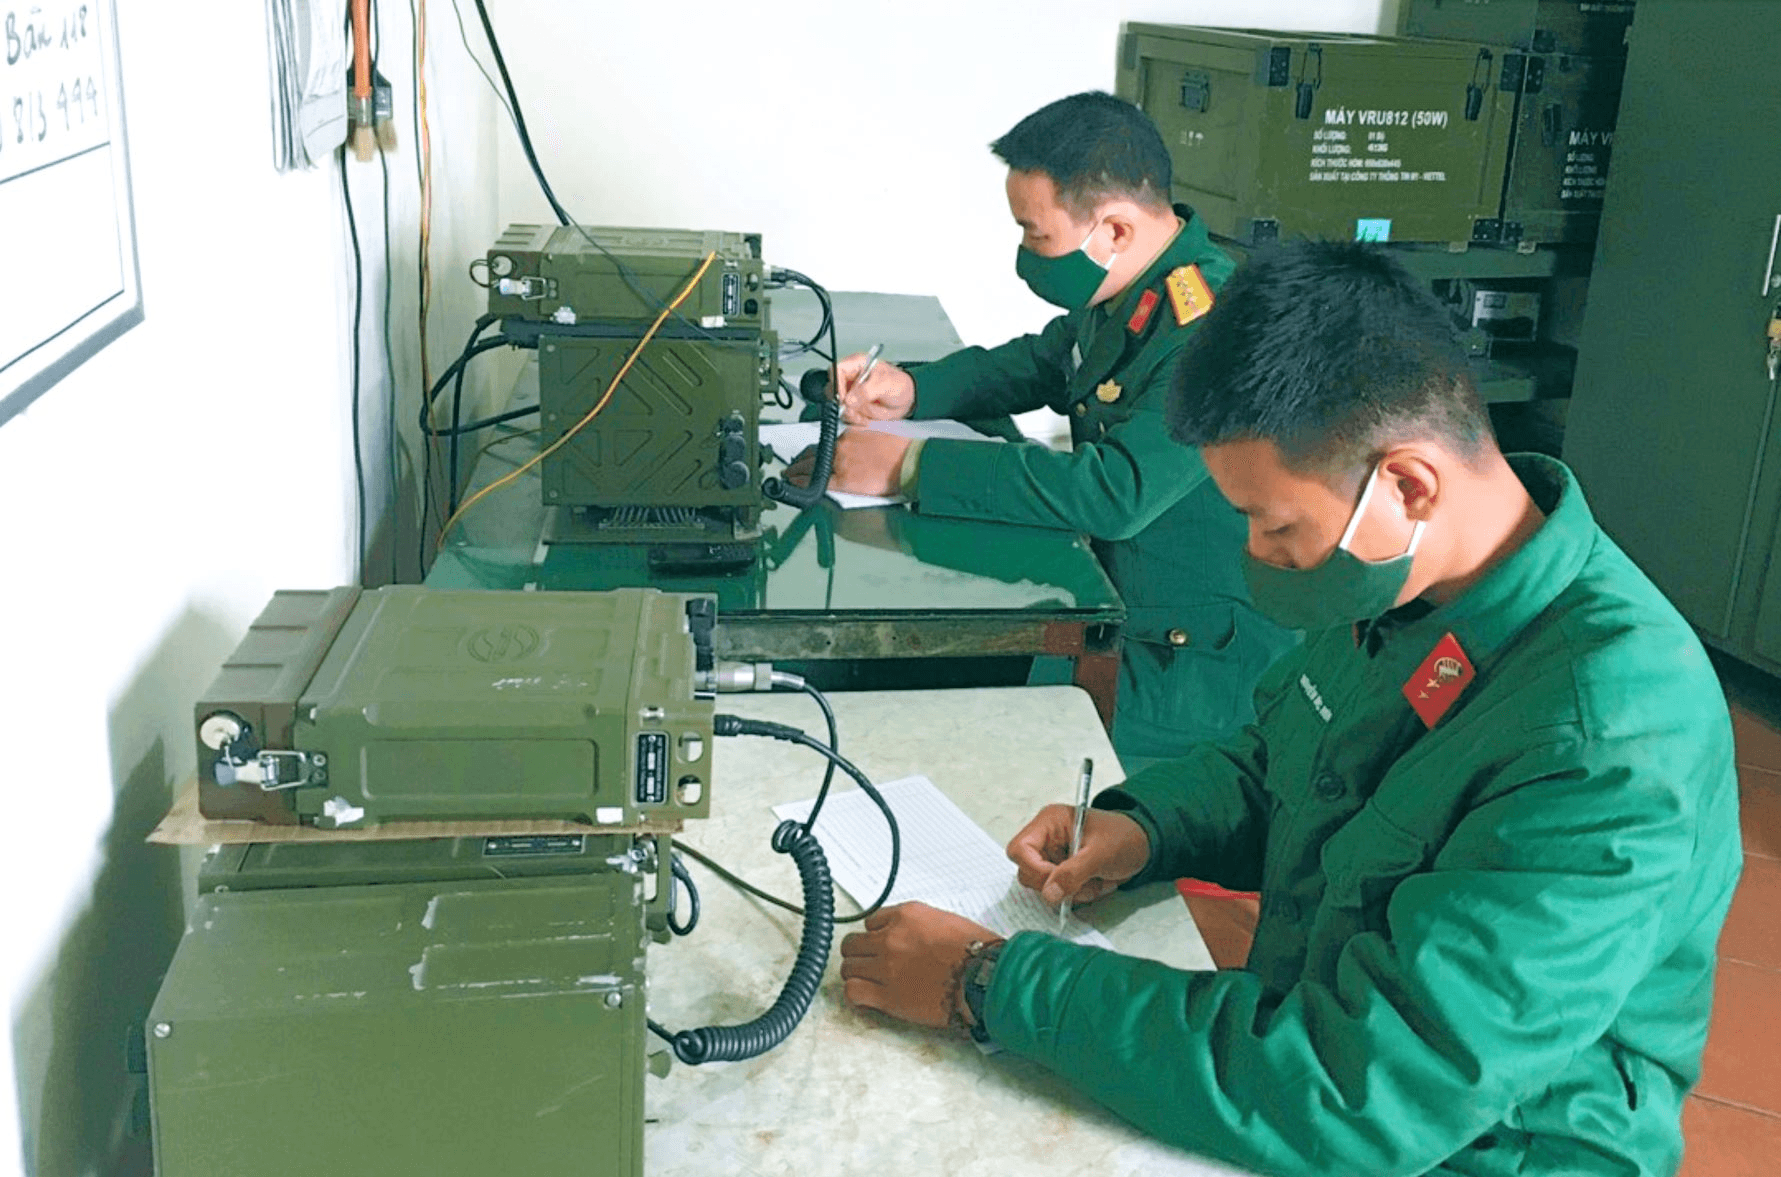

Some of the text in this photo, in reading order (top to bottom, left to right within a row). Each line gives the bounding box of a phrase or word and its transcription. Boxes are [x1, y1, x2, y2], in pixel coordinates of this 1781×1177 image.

[1324, 105, 1449, 129] MÁY VRU812 (50W)
[1568, 128, 1598, 146] MÁY
